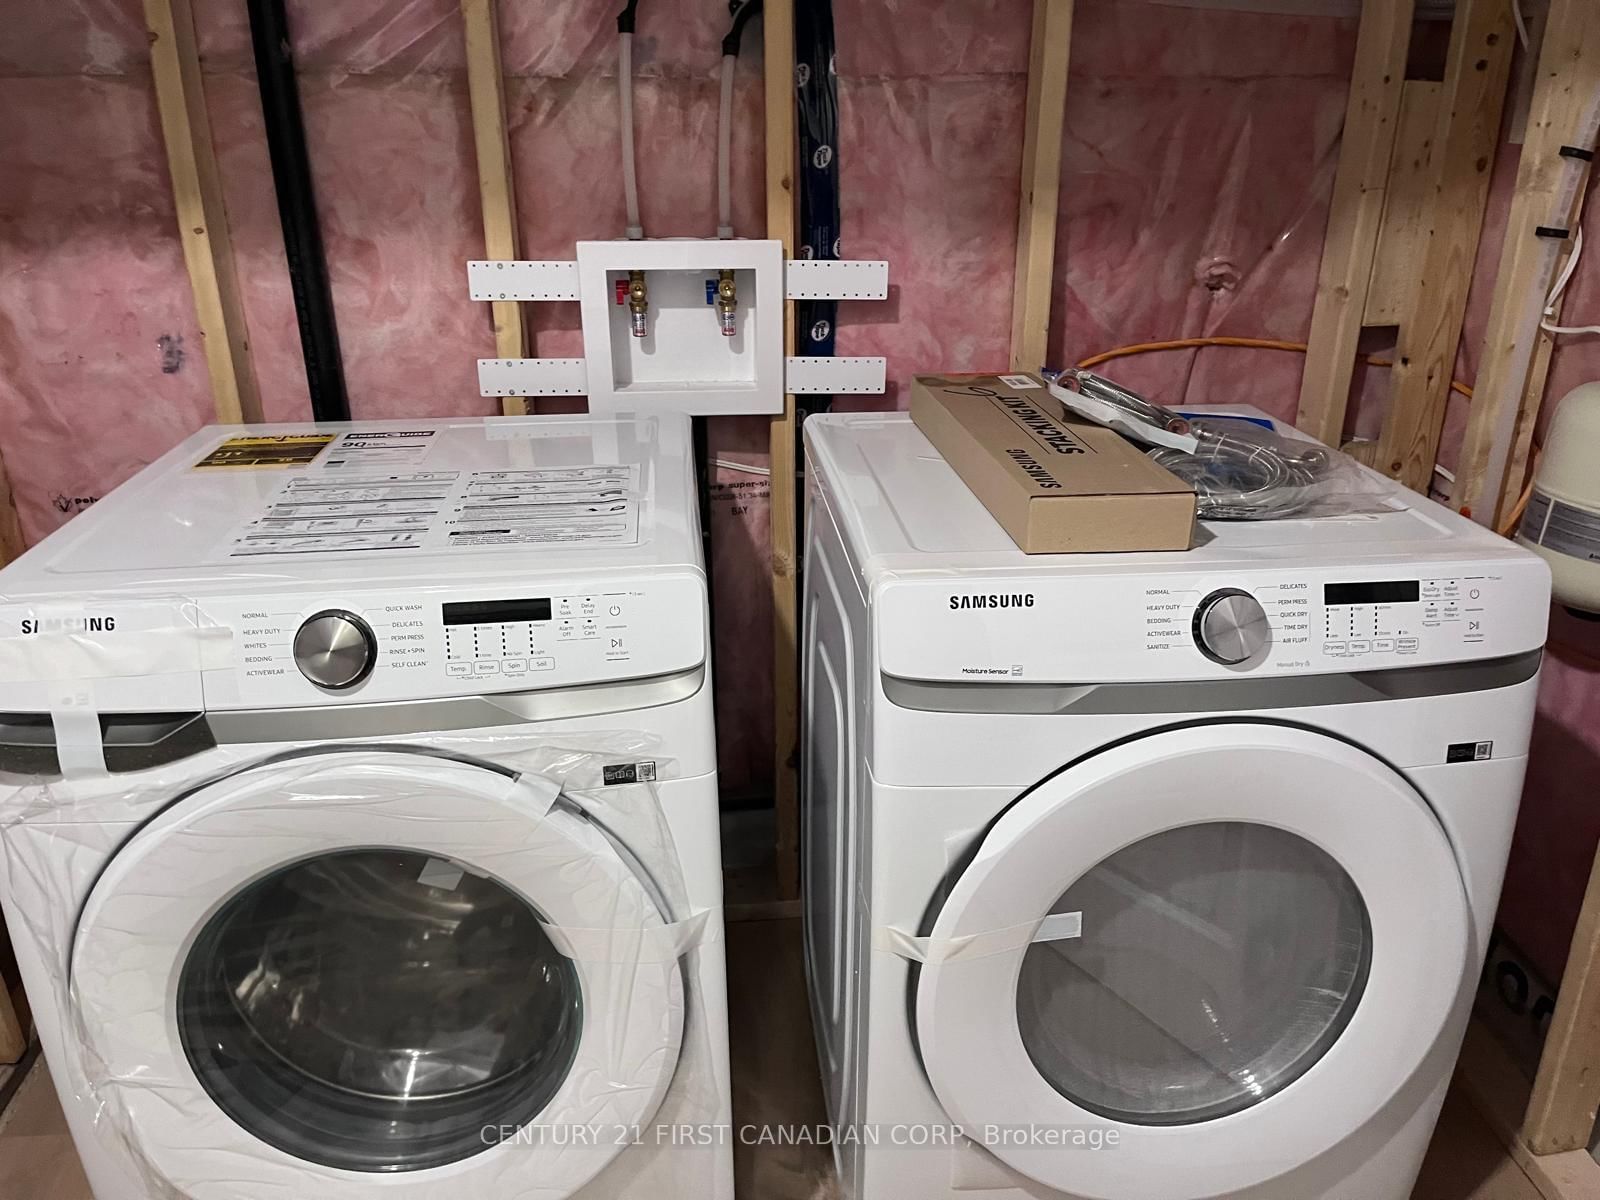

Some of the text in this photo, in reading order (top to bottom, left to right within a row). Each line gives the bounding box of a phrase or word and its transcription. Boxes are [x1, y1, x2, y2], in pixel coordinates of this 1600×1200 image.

[995, 396, 1085, 455] STACKING KIT
[1006, 449, 1062, 489] SAMSUNG
[949, 593, 1034, 610] SAMSUNG
[391, 620, 423, 628] DELICATES
[246, 668, 285, 676] ACTIVEWEAR
